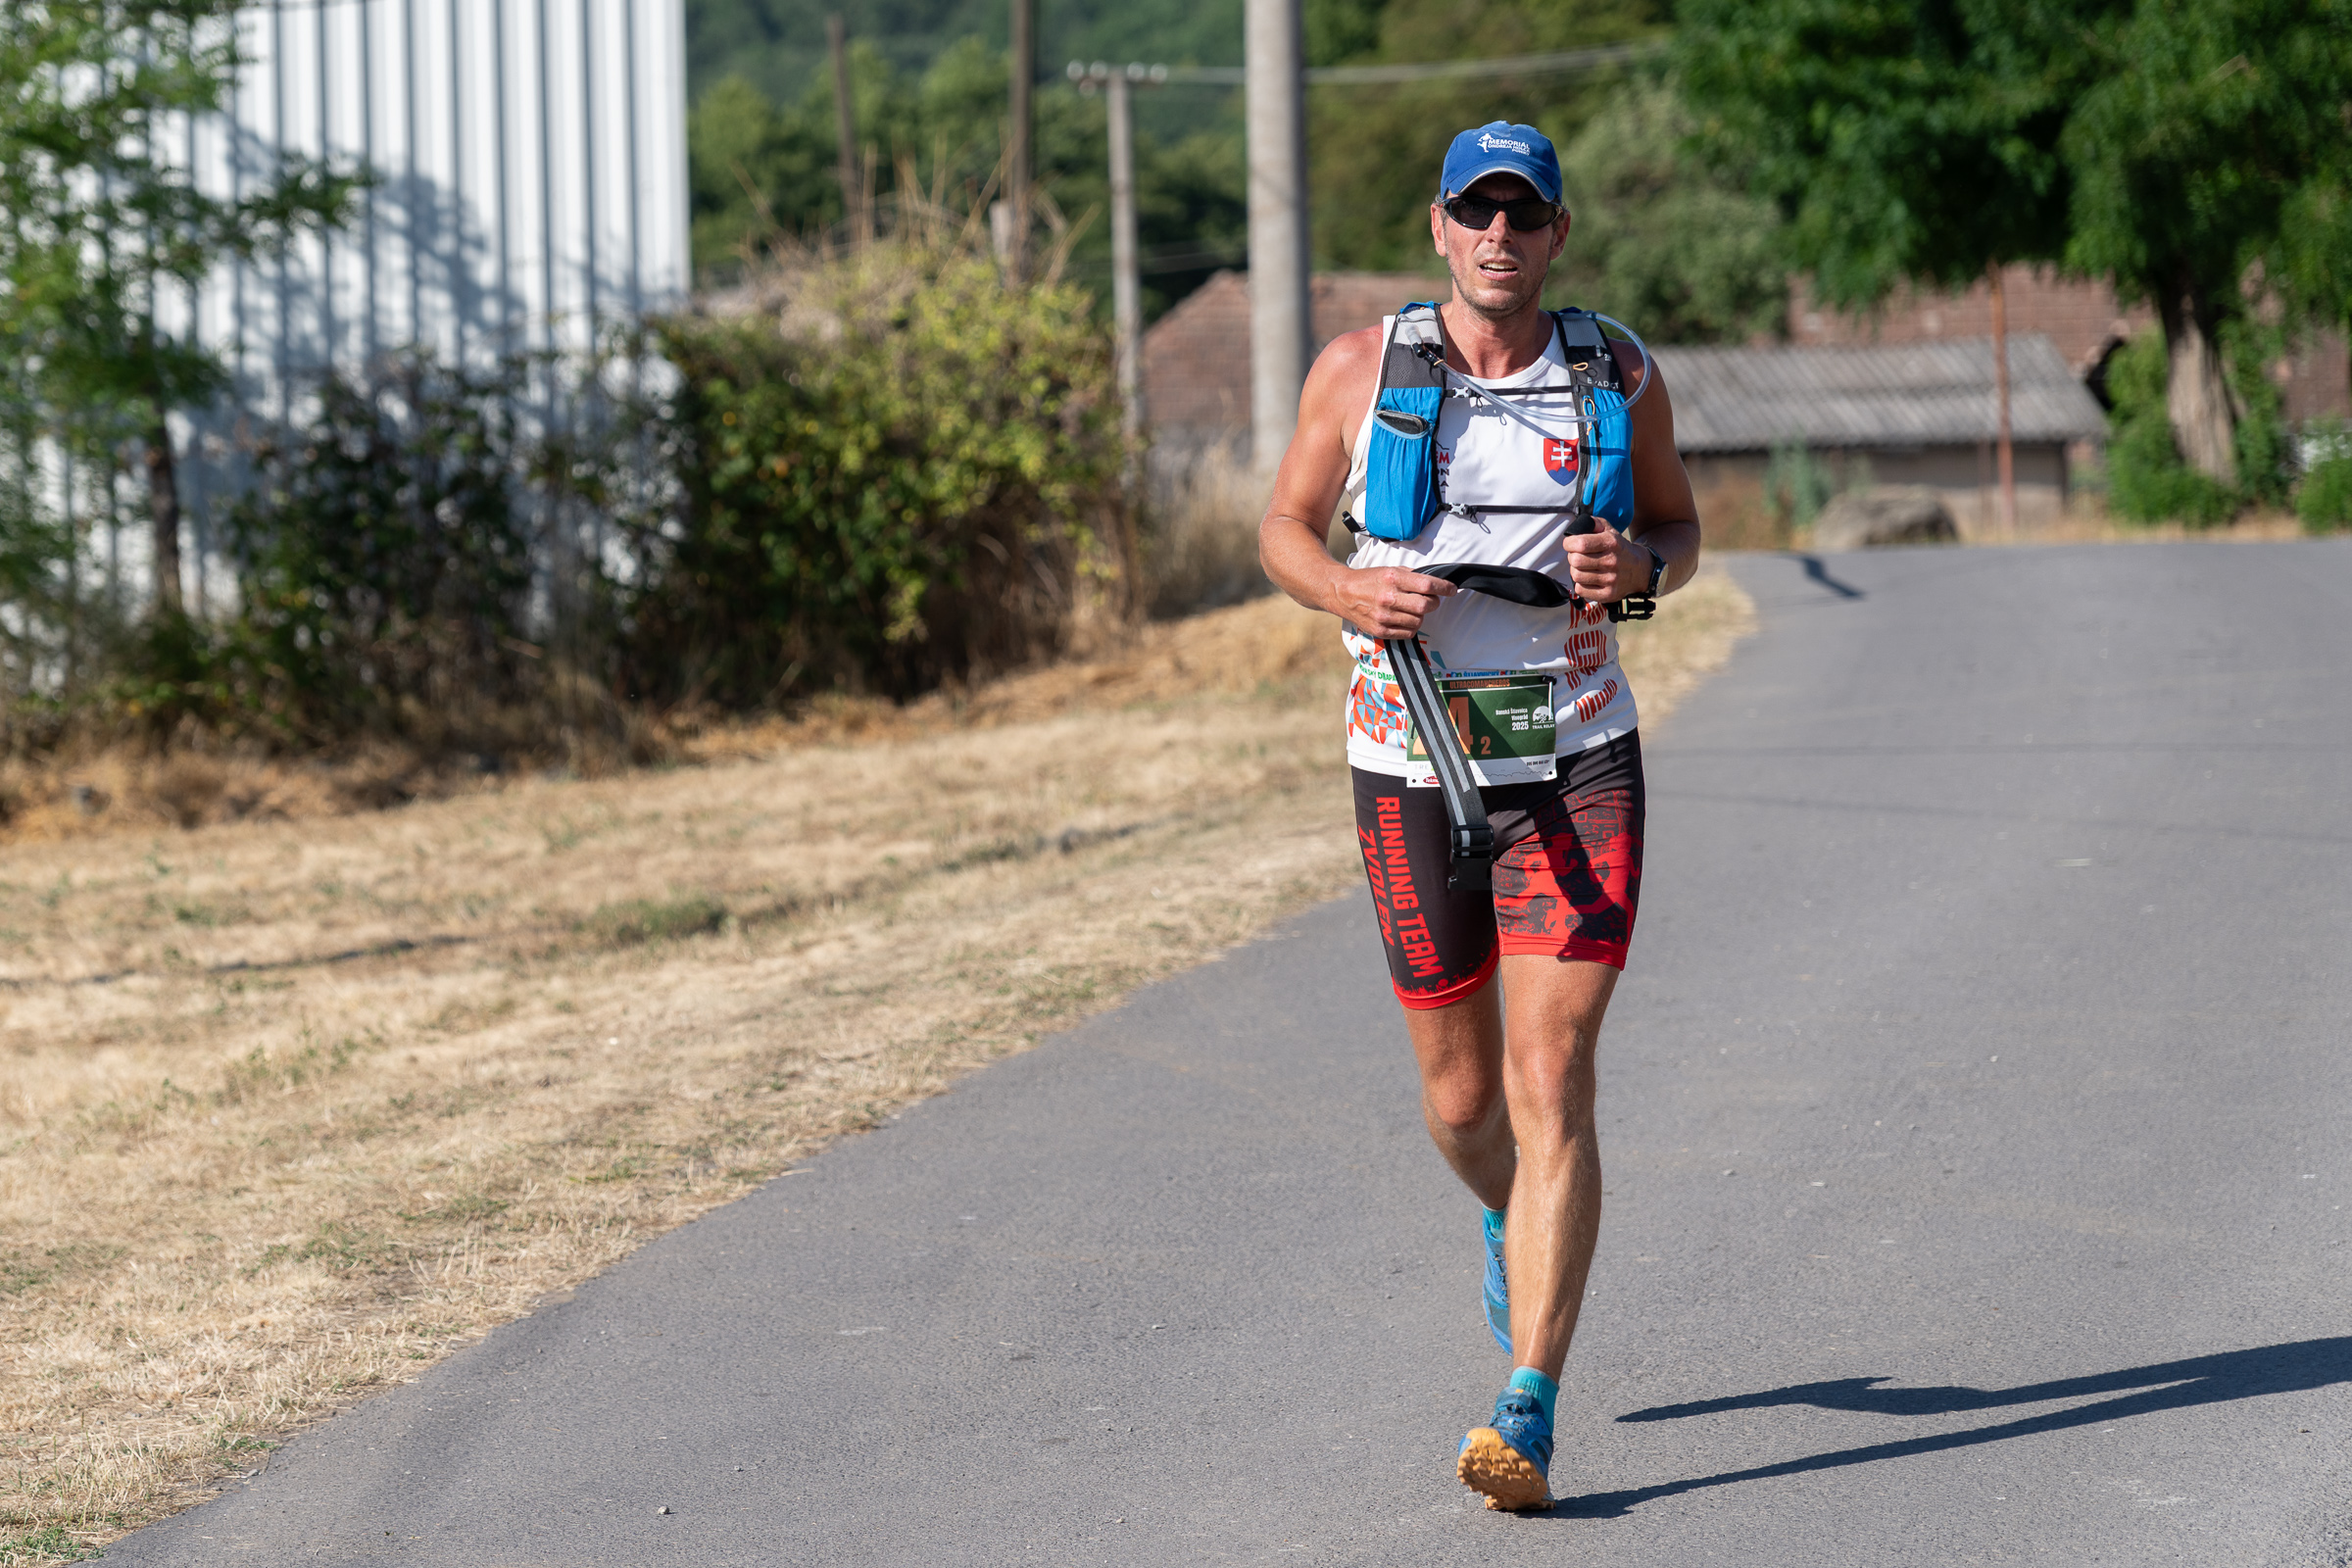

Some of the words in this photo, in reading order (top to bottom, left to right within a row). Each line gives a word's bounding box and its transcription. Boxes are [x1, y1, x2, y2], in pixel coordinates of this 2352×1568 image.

[1488, 138, 1529, 149] MEMORIAL
[1449, 679, 1511, 689] ULTRACOMANCHEROS
[1511, 721, 1529, 731] 2025
[1480, 736, 1492, 755] 2
[1376, 797, 1419, 910] RUNNING
[1357, 824, 1395, 947] ZVOLEN
[1396, 912, 1445, 978] TEAM
